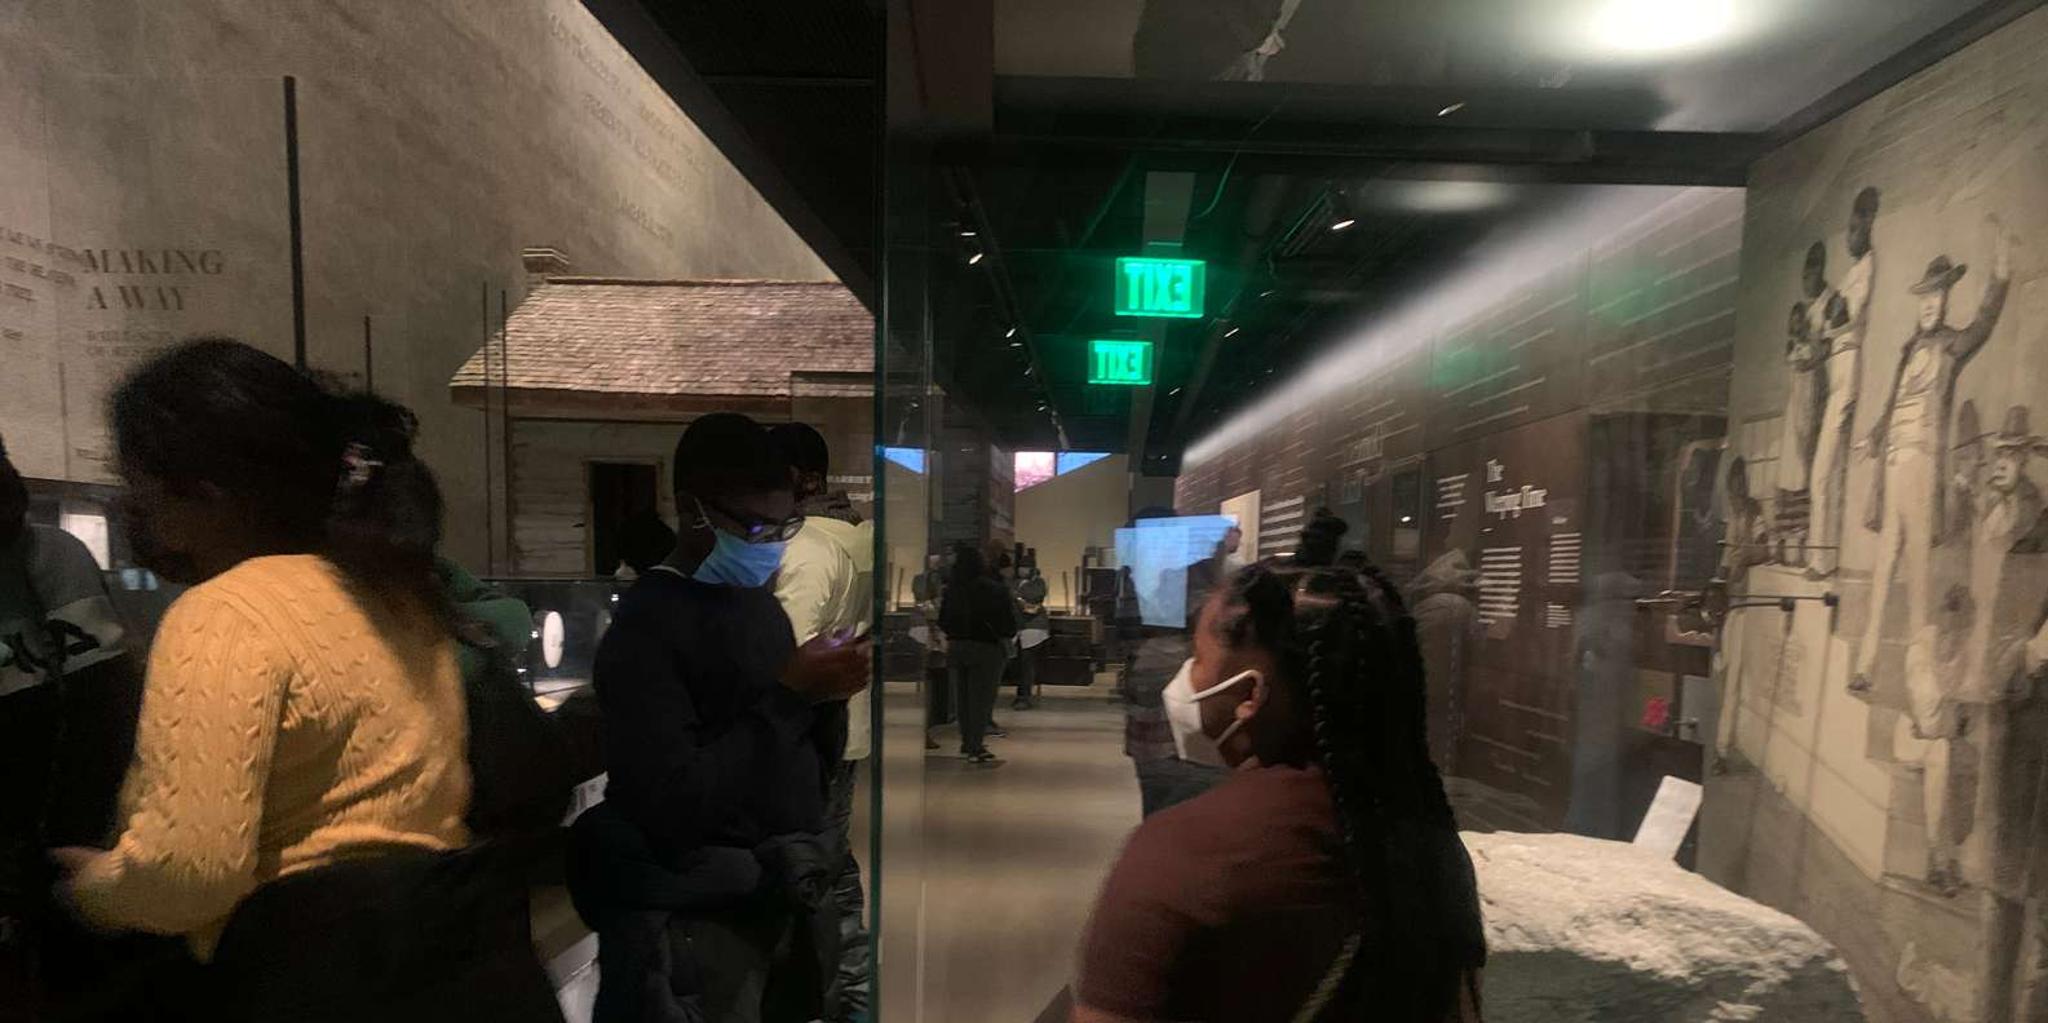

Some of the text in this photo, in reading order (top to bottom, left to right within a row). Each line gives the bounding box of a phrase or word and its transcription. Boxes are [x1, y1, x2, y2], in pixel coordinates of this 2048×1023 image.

[83, 248, 223, 274] MAKING
[86, 286, 187, 310] A WAY
